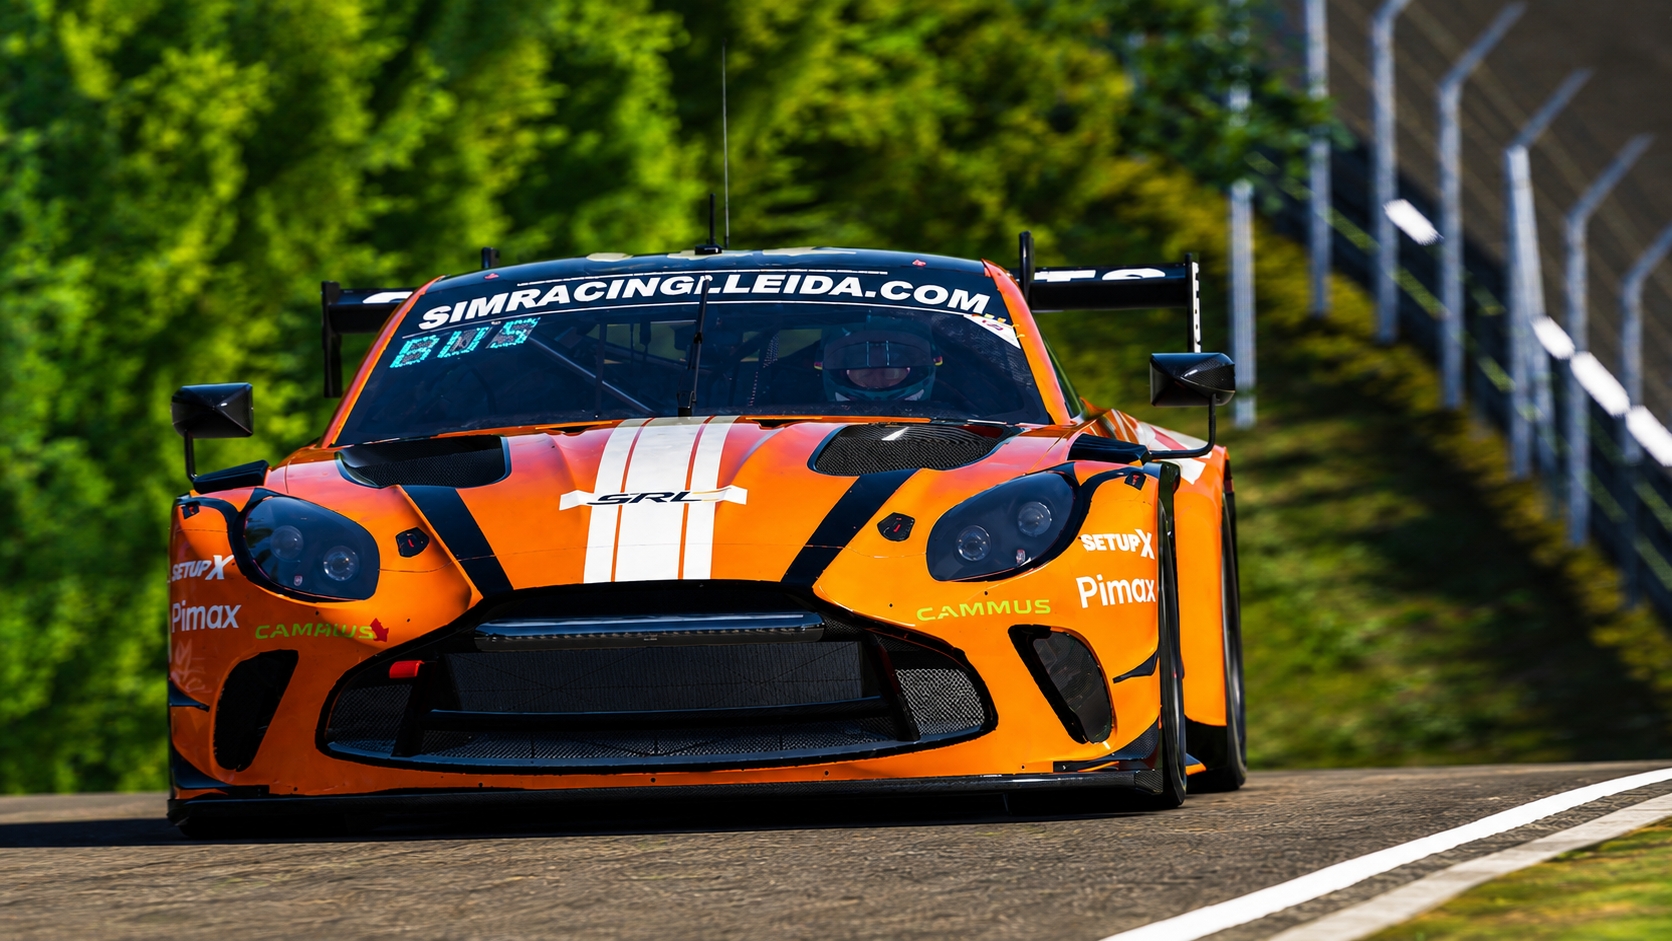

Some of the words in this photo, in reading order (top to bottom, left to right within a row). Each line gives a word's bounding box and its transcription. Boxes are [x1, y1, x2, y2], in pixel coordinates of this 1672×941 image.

[586, 491, 704, 506] SRL
[1080, 528, 1155, 560] SETUPX
[1076, 573, 1156, 608] Pimax
[171, 600, 241, 633] Pimax
[916, 599, 1051, 621] CAMMUS
